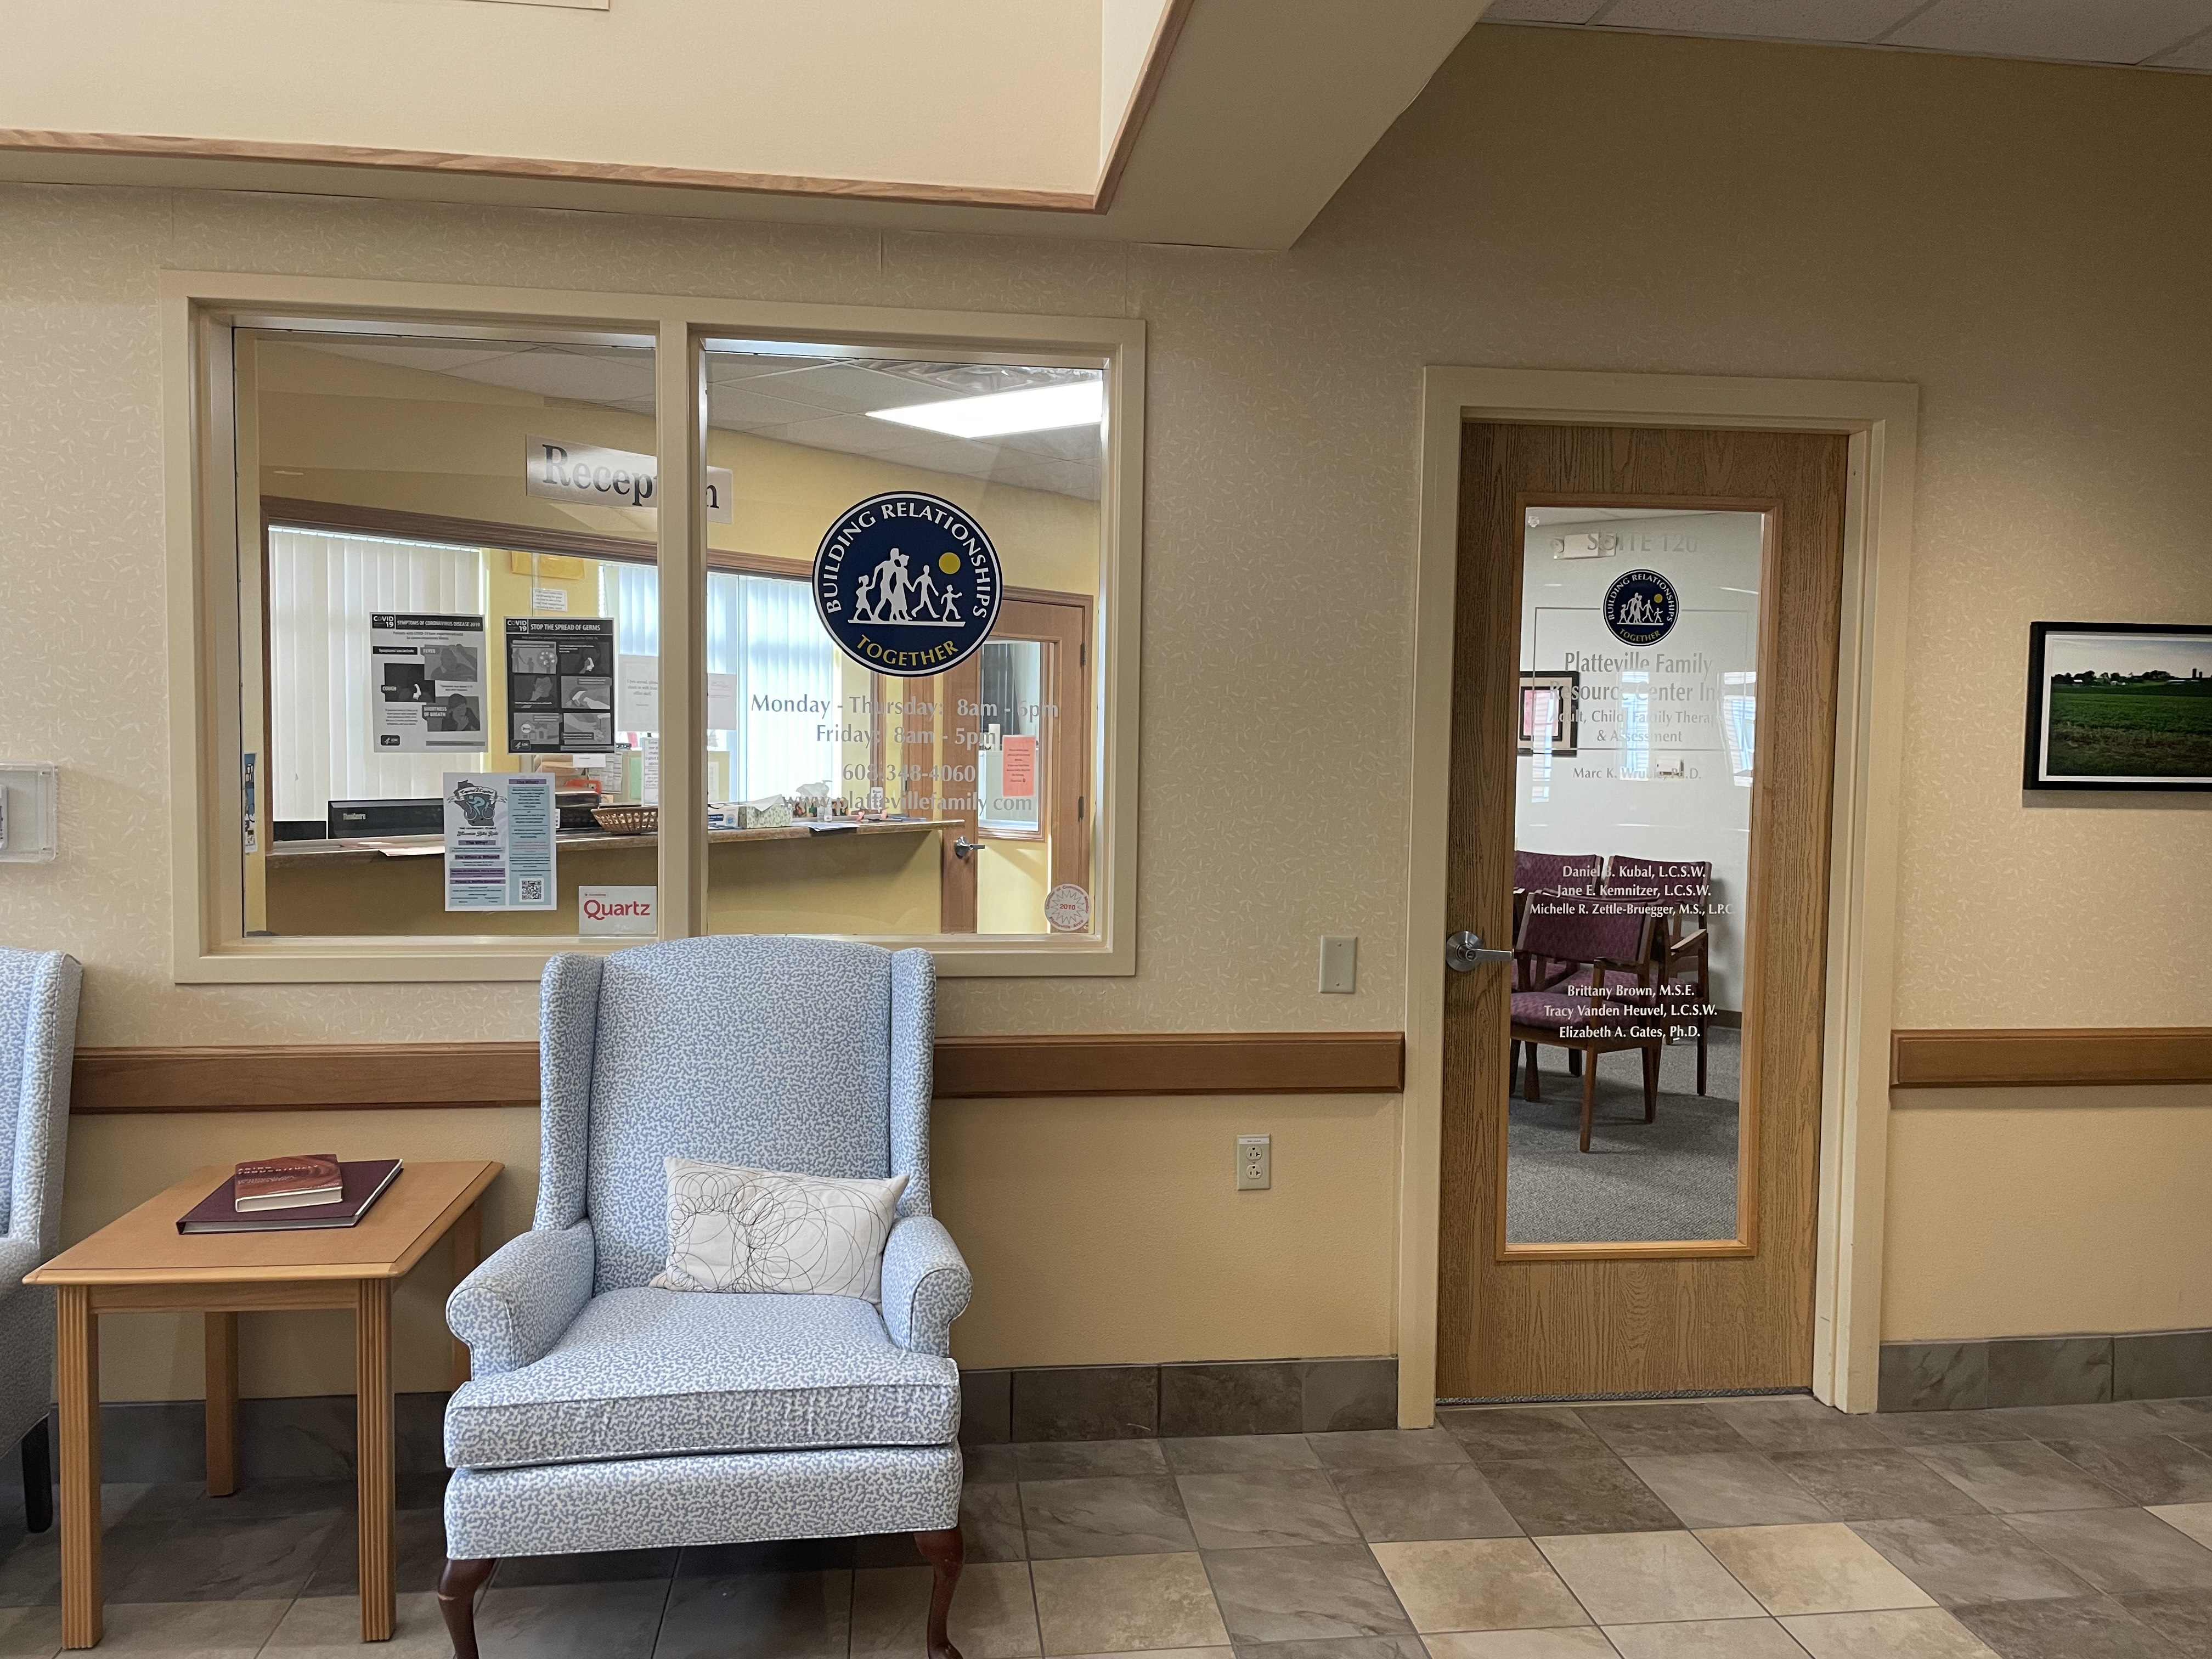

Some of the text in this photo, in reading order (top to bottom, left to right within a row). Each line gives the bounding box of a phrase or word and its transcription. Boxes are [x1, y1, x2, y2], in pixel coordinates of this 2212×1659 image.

[542, 444, 719, 508] Recepn
[1587, 533, 1699, 553] SUITE 120
[823, 502, 991, 618] BUILDING RELATIONSHIPS
[1607, 573, 1675, 622] BUILDING RELATIONSHIPS
[1620, 628, 1661, 642] TOGETHER
[856, 634, 959, 666] TOGETHER
[1565, 651, 1712, 681] Platteville Family
[751, 694, 831, 719] Monday
[849, 695, 944, 721] Thursday:
[957, 698, 997, 717] 8am
[1675, 710, 1718, 727] Therap
[817, 724, 881, 748] Friday:
[894, 726, 934, 744] 8am
[954, 727, 996, 751] 5pm
[1596, 729, 1606, 741] &
[1573, 768, 1602, 778] Marc
[1606, 768, 1617, 778] K.
[1672, 768, 1702, 780] P.D.
[781, 791, 1032, 816] wwwplattevillefamilycom
[1563, 865, 1706, 879] Daniel B. Kubal, L.C.S.W.
[1556, 884, 1711, 898] Jane E. Kemnitzer, L.C.S.W.
[584, 899, 650, 921] Quartz
[1530, 903, 1575, 914] Michelle
[1578, 904, 1589, 914] R.
[1592, 903, 1675, 917] Zettle-Bruegger,
[1679, 904, 1705, 916] M.S.,
[1567, 984, 1695, 1000] Brittany Brown, M.S.E.
[1544, 1003, 1717, 1020] Tracy Vanden Heuvel, L.C.S.W.
[1560, 1025, 1701, 1040] Elizabeth A. Gates, Ph.D.
